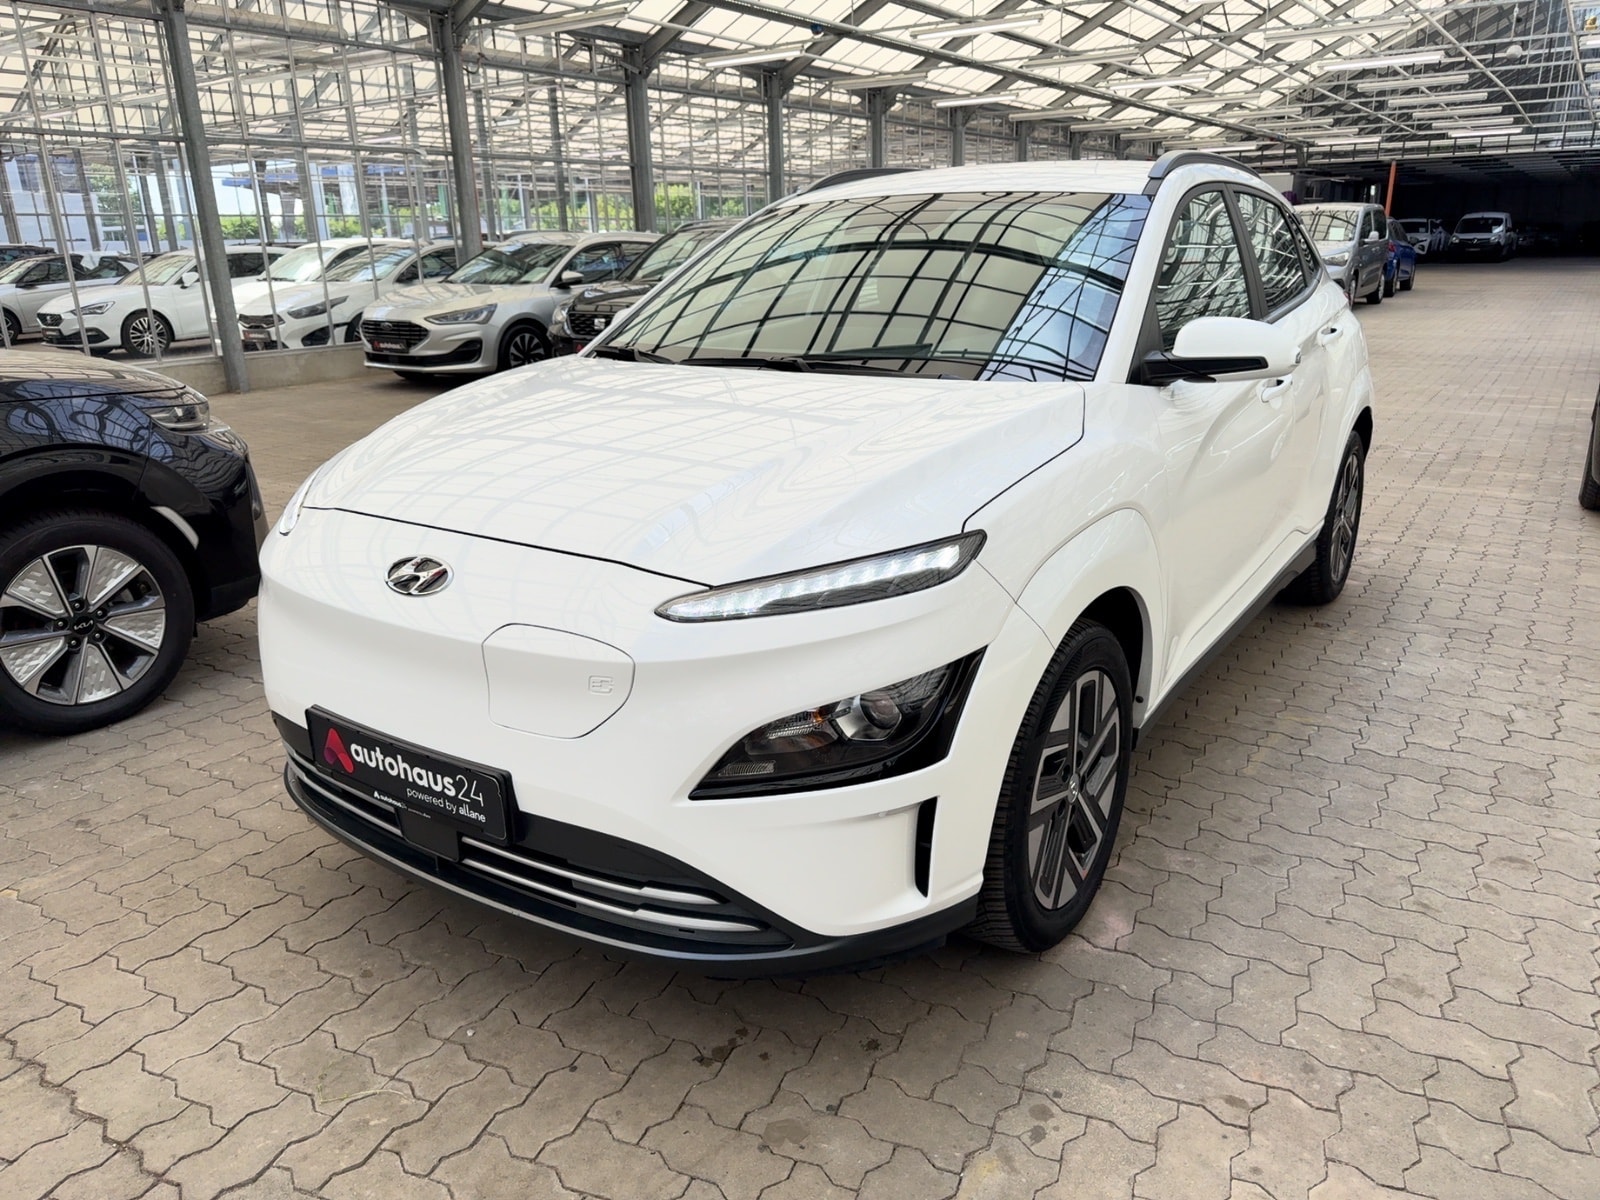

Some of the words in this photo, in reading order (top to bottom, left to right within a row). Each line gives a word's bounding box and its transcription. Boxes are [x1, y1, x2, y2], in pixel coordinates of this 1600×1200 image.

[350, 742, 484, 807] autohaus24
[406, 787, 444, 807] powered
[445, 799, 457, 814] by
[458, 804, 486, 823] allane
